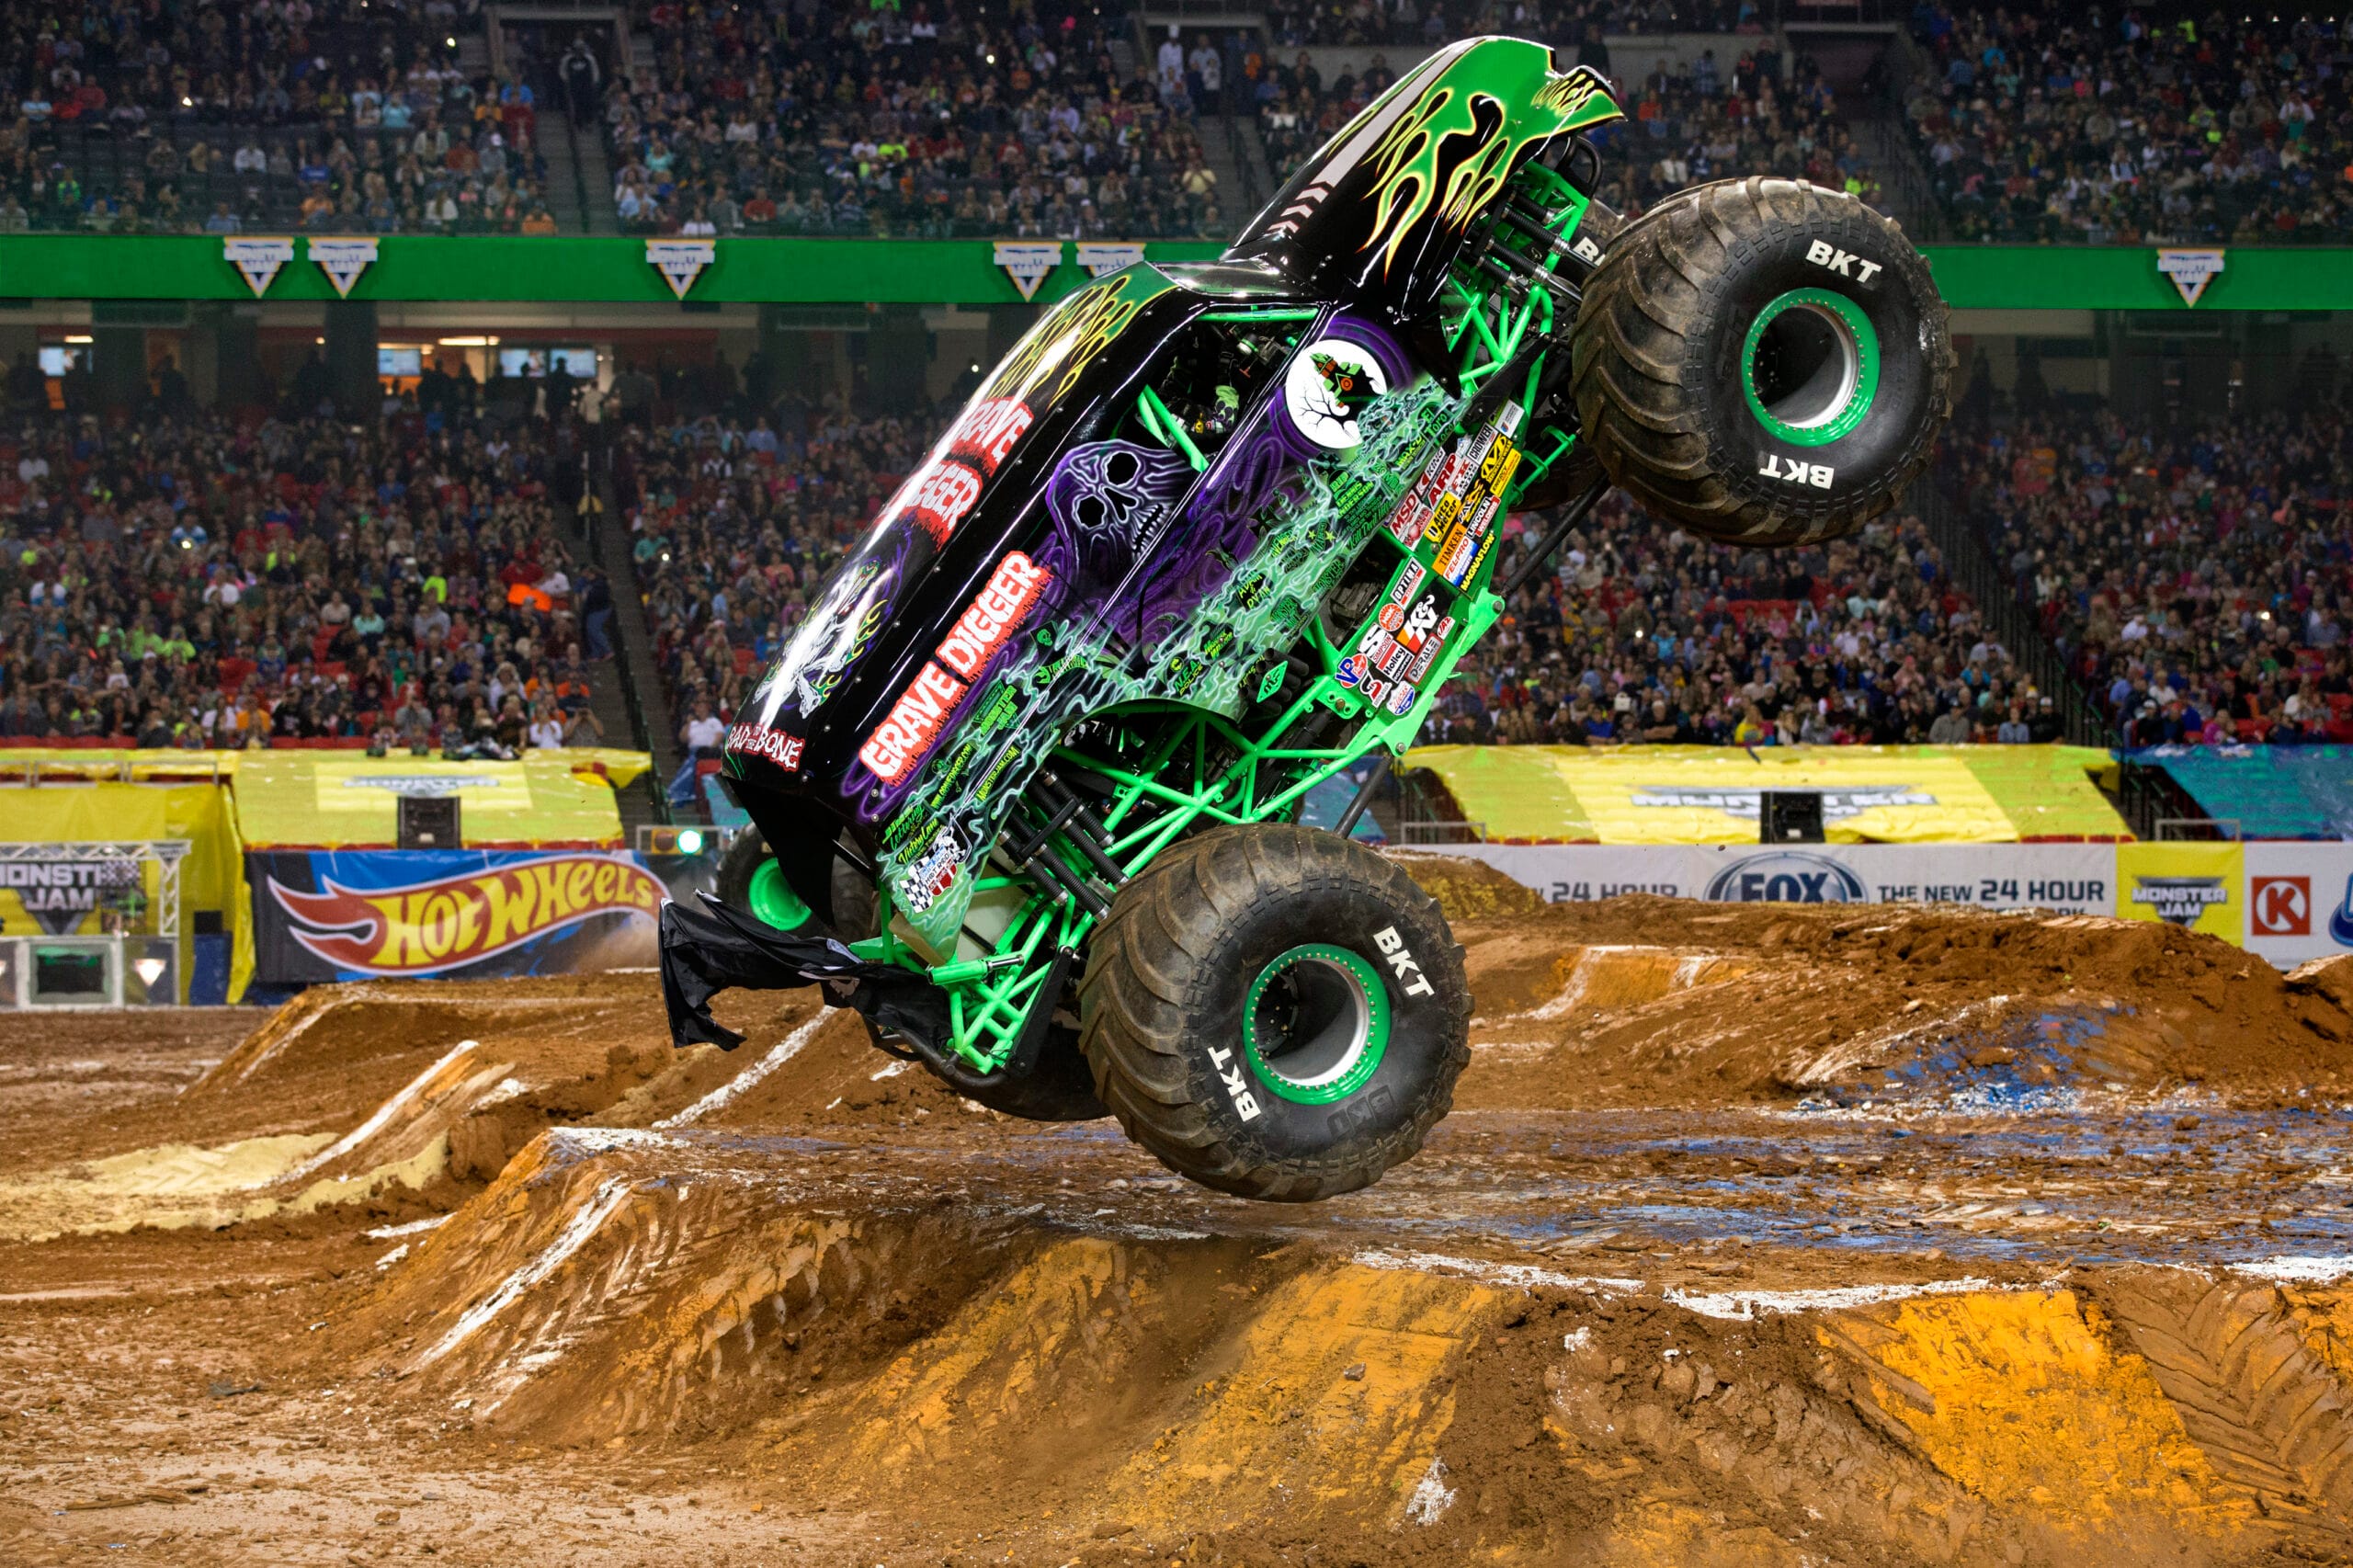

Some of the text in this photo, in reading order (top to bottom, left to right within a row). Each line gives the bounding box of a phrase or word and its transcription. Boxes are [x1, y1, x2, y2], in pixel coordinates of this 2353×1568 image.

[1805, 239, 1882, 283] BKT
[951, 399, 1034, 465] RAVE
[1468, 423, 1493, 460] CROWER
[1427, 448, 1444, 477] KING
[1427, 452, 1457, 506] ARP
[1759, 454, 1835, 490] BKT
[901, 461, 981, 531] GGER
[1392, 492, 1417, 535] MSD
[1467, 498, 1491, 537] LINCOLN
[1477, 500, 1498, 533] WELDERS
[1438, 528, 1463, 567] TIMKEN
[1460, 531, 1495, 591] MAGNAFLOW
[1393, 561, 1418, 600] OPTIMA
[864, 552, 1042, 778] GRAVE DIGGER
[1372, 633, 1392, 663] SIMPSON
[1383, 646, 1405, 676] Holley
[1410, 639, 1438, 679] DERALE
[1178, 664, 1203, 696] POLICE
[1336, 655, 1359, 684] VP
[724, 725, 749, 750] BAD
[753, 728, 802, 768] BONE
[0, 862, 103, 887] ONST
[1552, 881, 1591, 902] 24
[1740, 872, 1829, 903] FOX
[1877, 879, 2105, 902] THE NEW 24 HOUR
[26, 888, 95, 911] JAM
[2131, 887, 2228, 903] MONSTER
[2158, 903, 2202, 917] JAM
[368, 889, 485, 966] HOT
[1372, 926, 1436, 998] BKT
[1208, 1045, 1263, 1122] BKT
